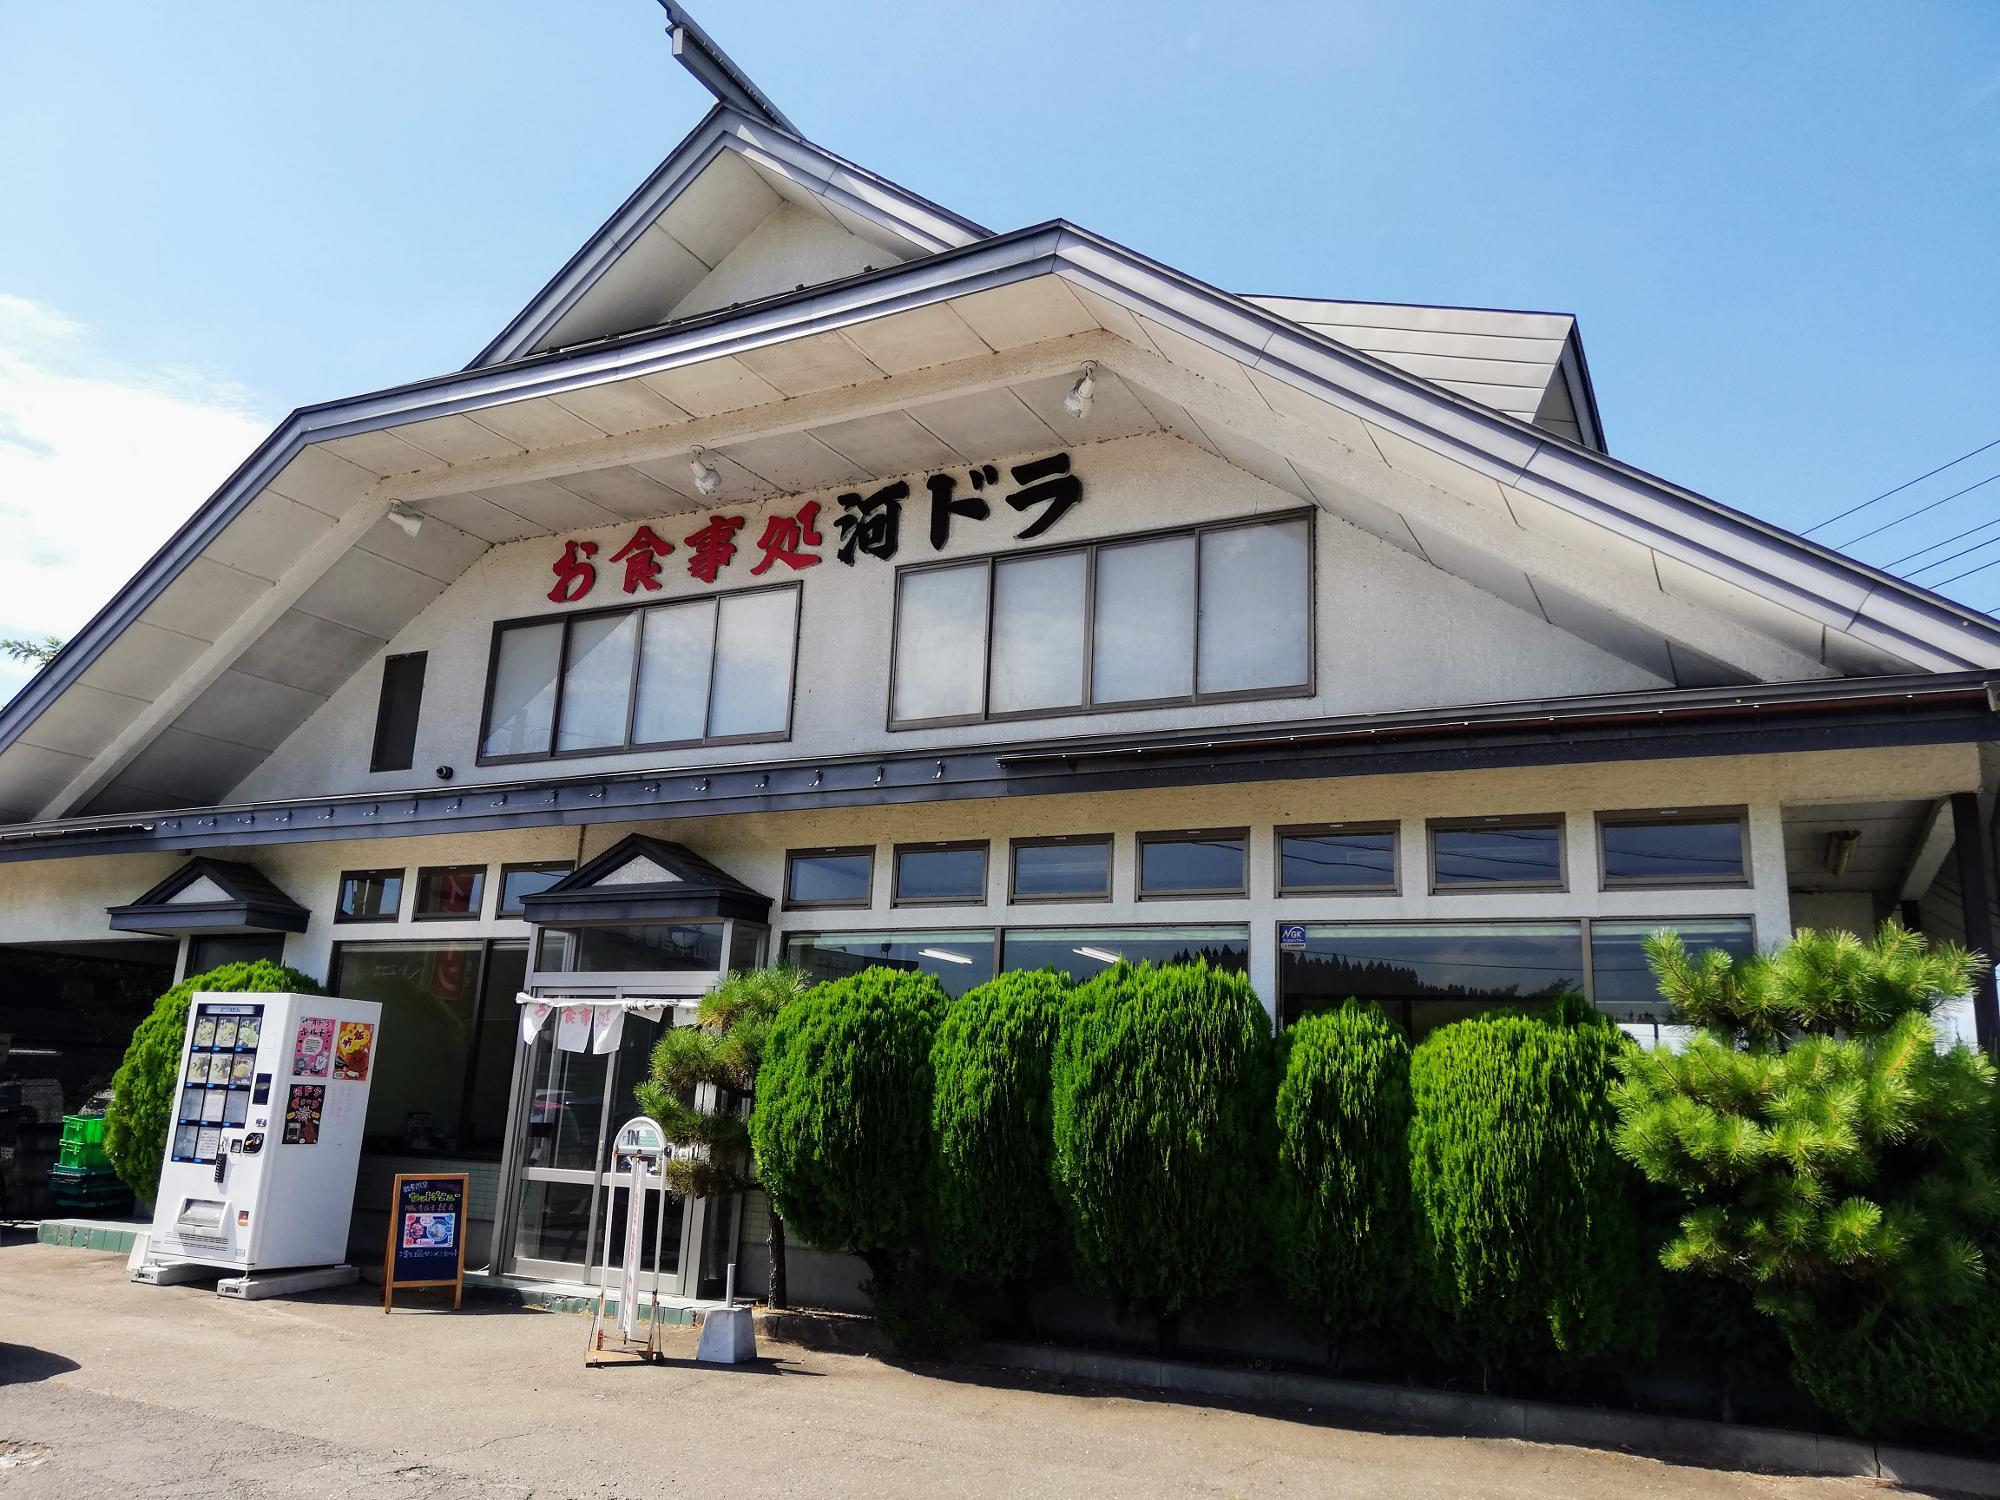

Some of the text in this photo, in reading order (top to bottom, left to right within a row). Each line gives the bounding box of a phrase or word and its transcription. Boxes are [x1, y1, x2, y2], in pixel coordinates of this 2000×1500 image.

[546, 451, 1084, 604] お食事処 河ドラ
[1281, 926, 1304, 939] NGK
